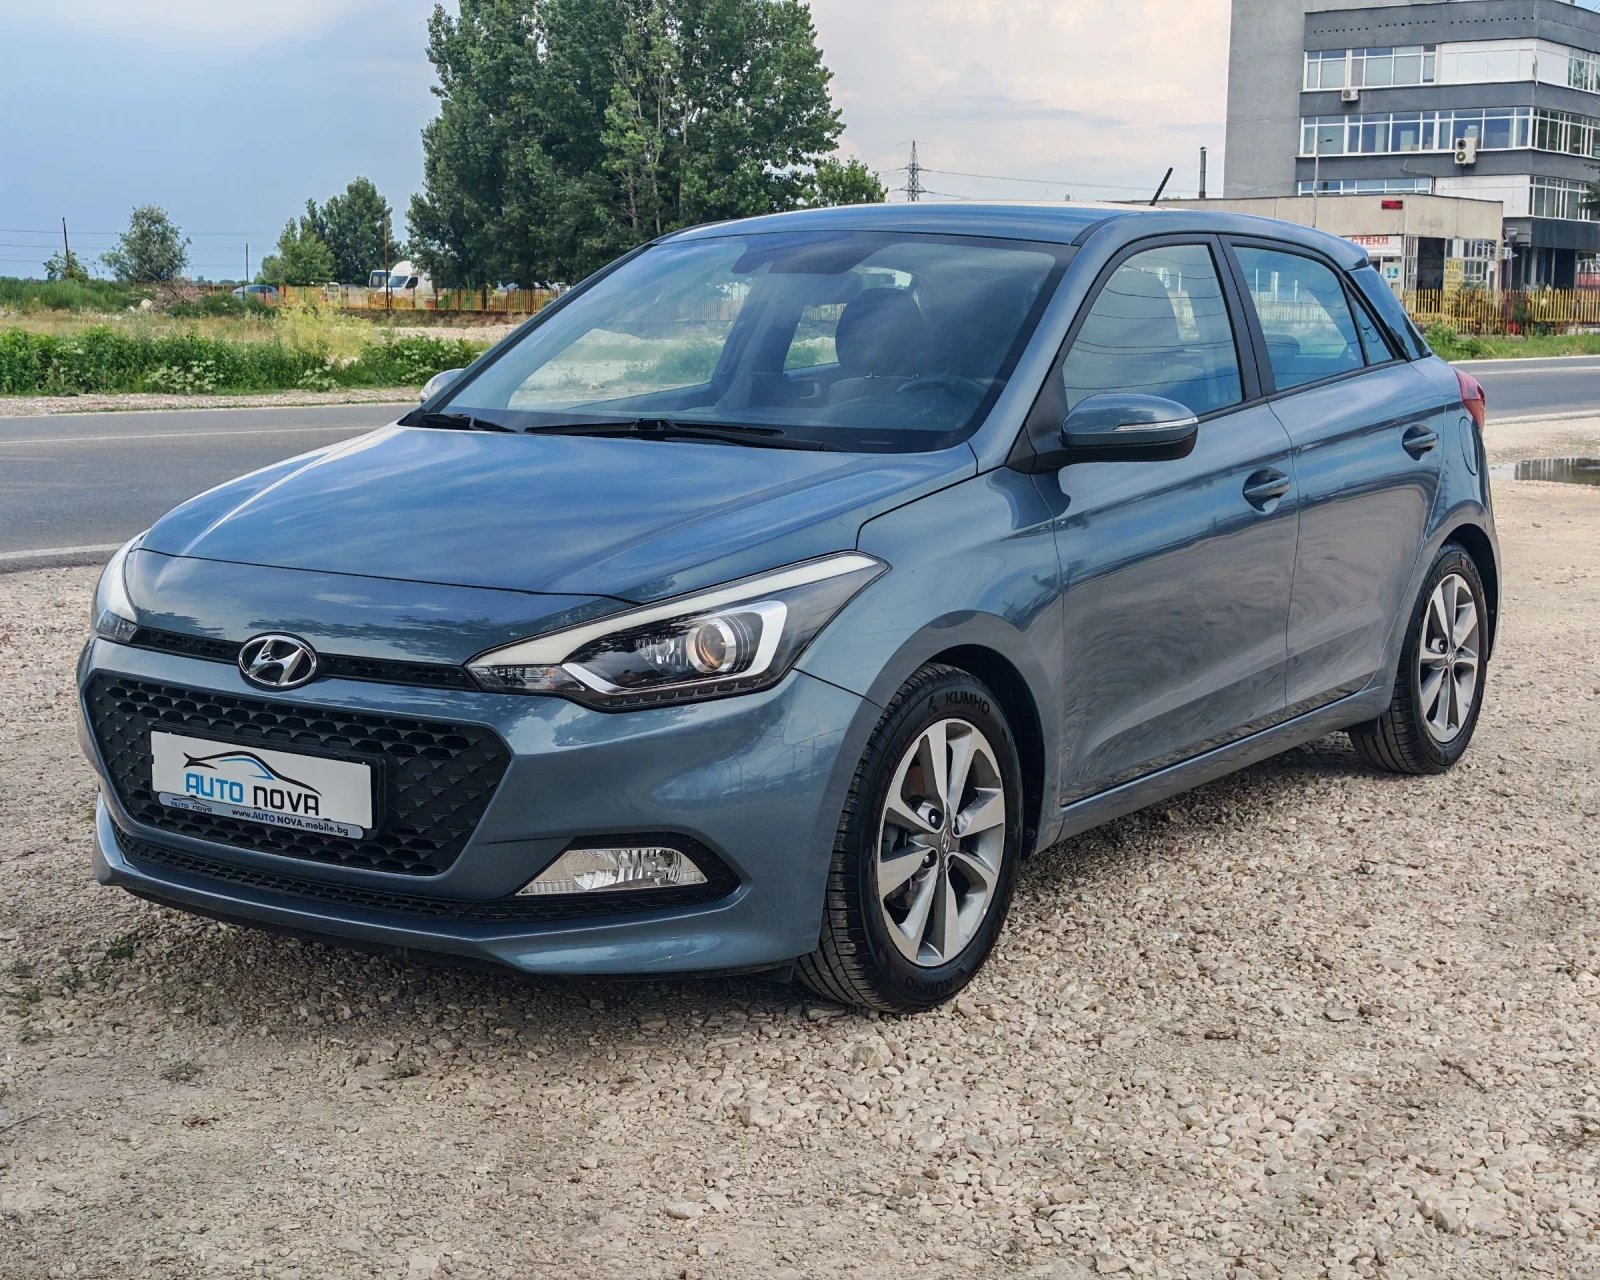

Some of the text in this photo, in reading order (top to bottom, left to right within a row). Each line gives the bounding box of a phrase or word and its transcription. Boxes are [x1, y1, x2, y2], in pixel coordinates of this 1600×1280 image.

[1351, 235, 1389, 246] СТЕНД
[945, 691, 990, 715] KUMHO
[185, 772, 320, 816] AUTO NOVA
